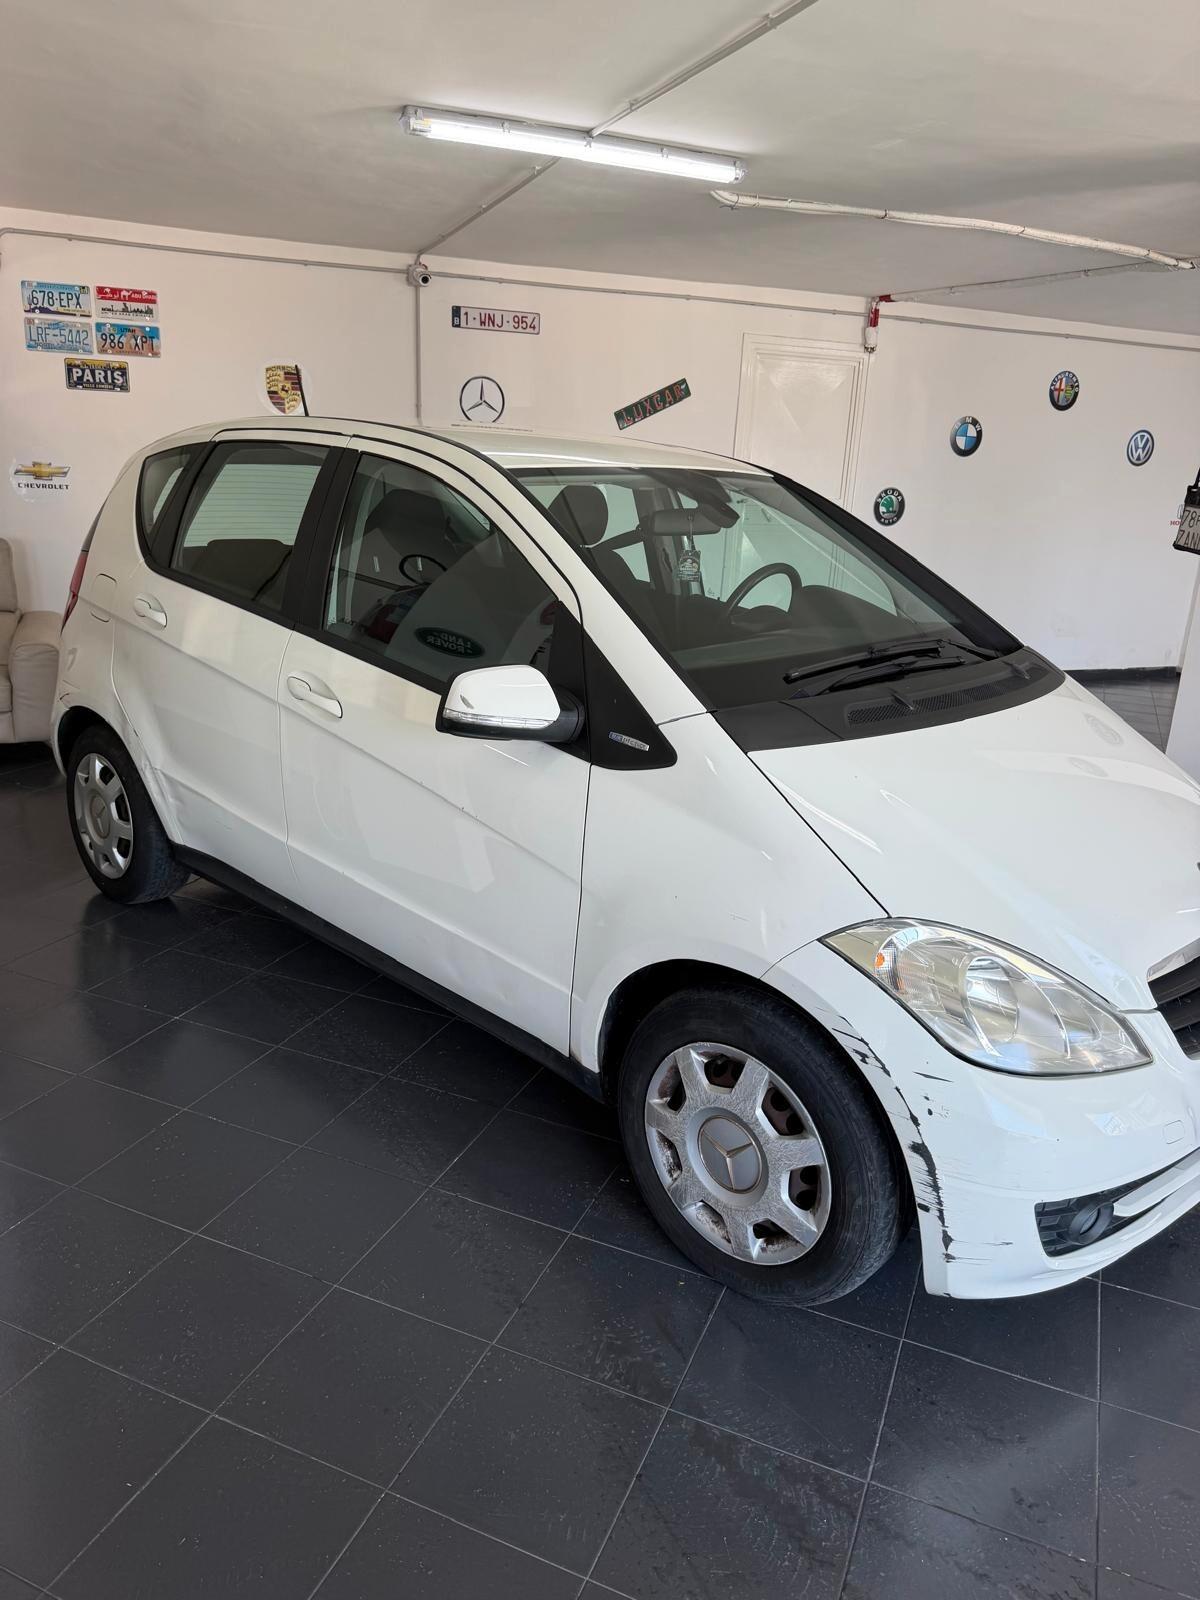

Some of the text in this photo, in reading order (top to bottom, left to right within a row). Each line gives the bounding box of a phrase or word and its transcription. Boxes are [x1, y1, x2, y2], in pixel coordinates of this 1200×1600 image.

[29, 325, 90, 346] LRF-5442
[100, 332, 156, 352] 986 XPT
[72, 368, 124, 384] PARIS
[621, 384, 686, 426] LUXCAR
[17, 482, 70, 490] CHEVROLET
